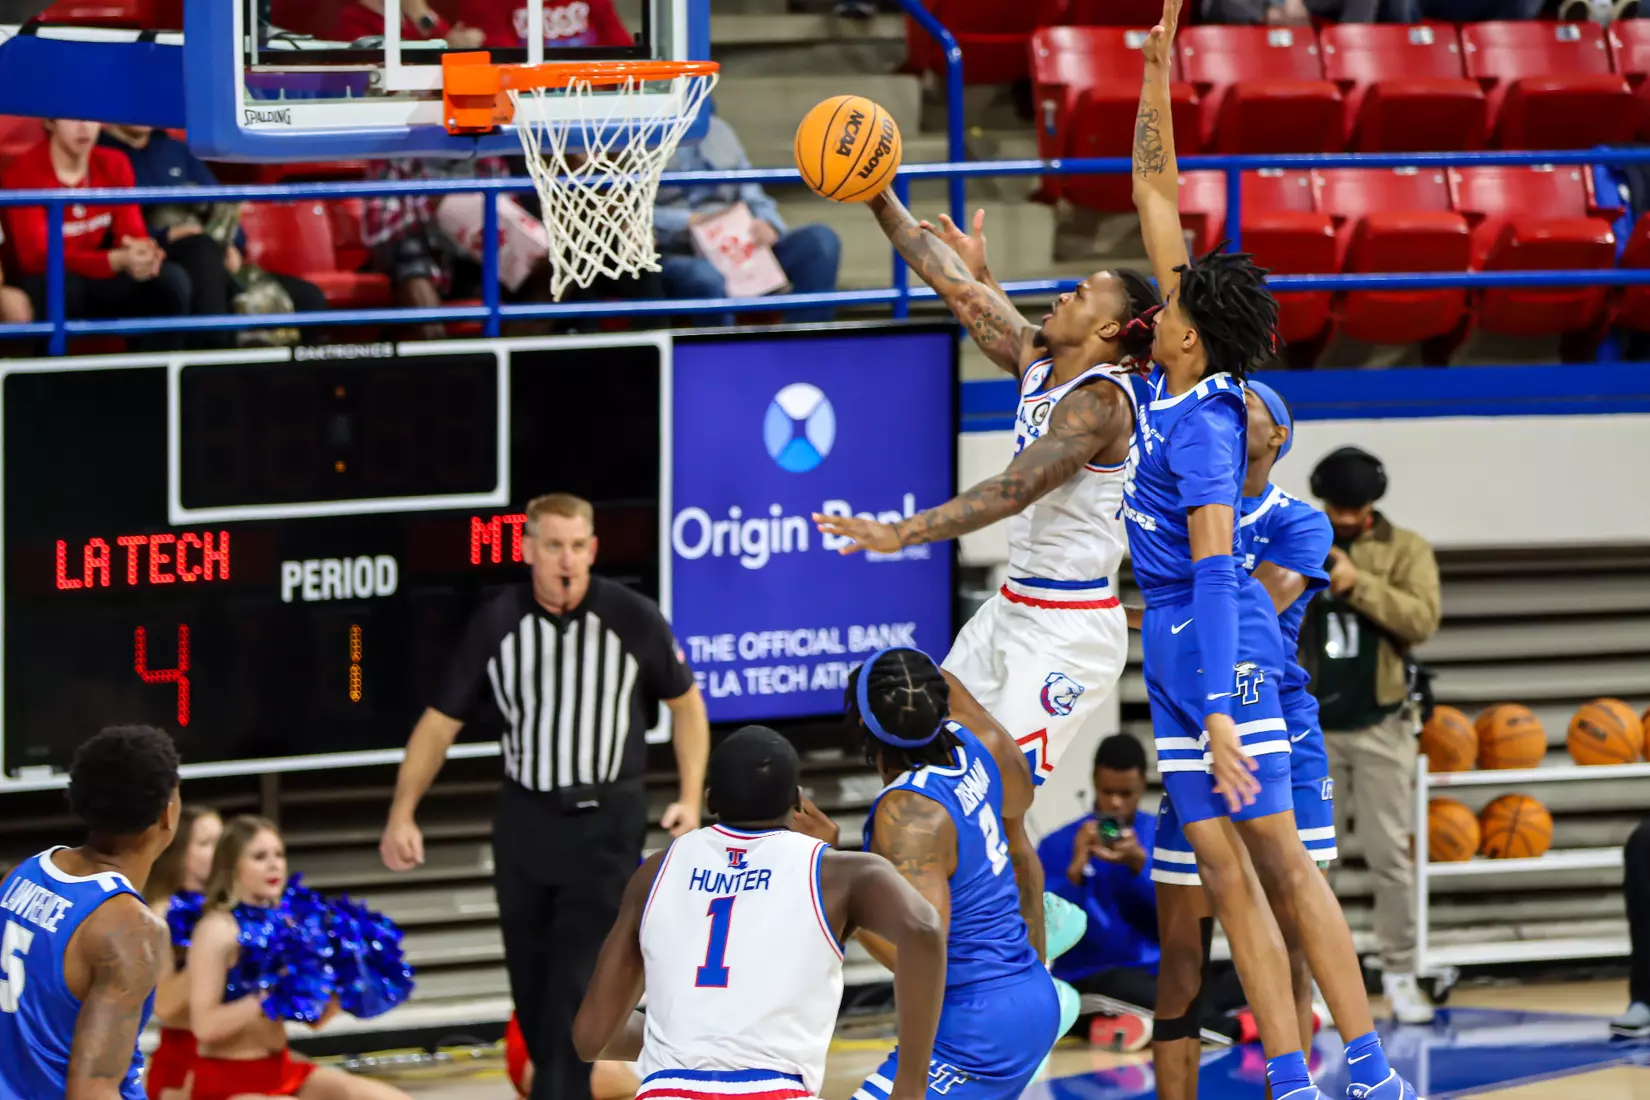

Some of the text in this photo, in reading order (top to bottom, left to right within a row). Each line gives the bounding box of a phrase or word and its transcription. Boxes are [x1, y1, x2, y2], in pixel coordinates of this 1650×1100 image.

[244, 108, 291, 126] SPALDING
[835, 109, 866, 157] NCAA
[56, 530, 230, 590] LA TECH
[672, 502, 809, 570] Origin
[281, 555, 398, 603] PERIOD
[350, 624, 363, 702] 1
[686, 621, 917, 664] THE OFFICIAL BANK
[134, 623, 191, 727] 4
[709, 669, 743, 698] LA
[743, 664, 808, 696] TECH
[978, 801, 1008, 877] 2
[689, 868, 772, 894] HUNTER
[0, 919, 35, 1013] 5
[694, 895, 737, 988] 1
